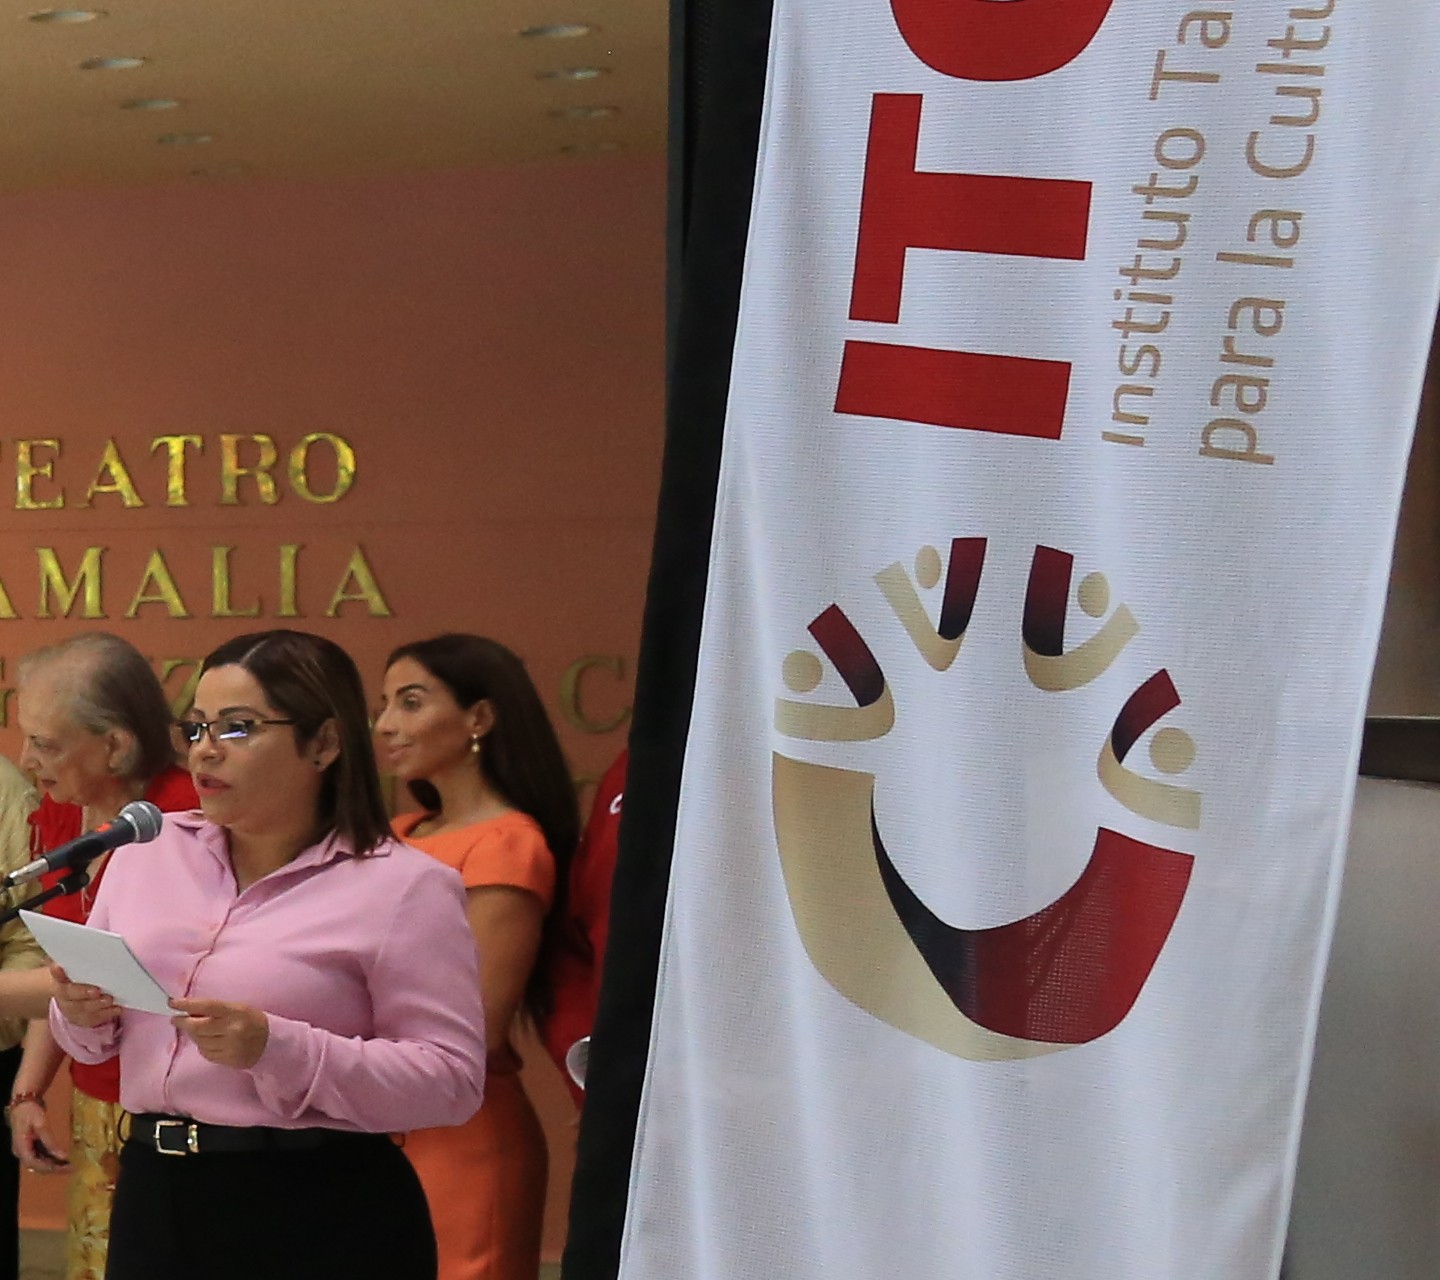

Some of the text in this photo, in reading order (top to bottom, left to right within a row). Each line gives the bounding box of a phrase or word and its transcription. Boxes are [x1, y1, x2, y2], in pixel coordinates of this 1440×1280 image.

[1101, 126, 1209, 448] Instituto
[1215, 208, 1305, 270] la
[1197, 295, 1287, 466] para
